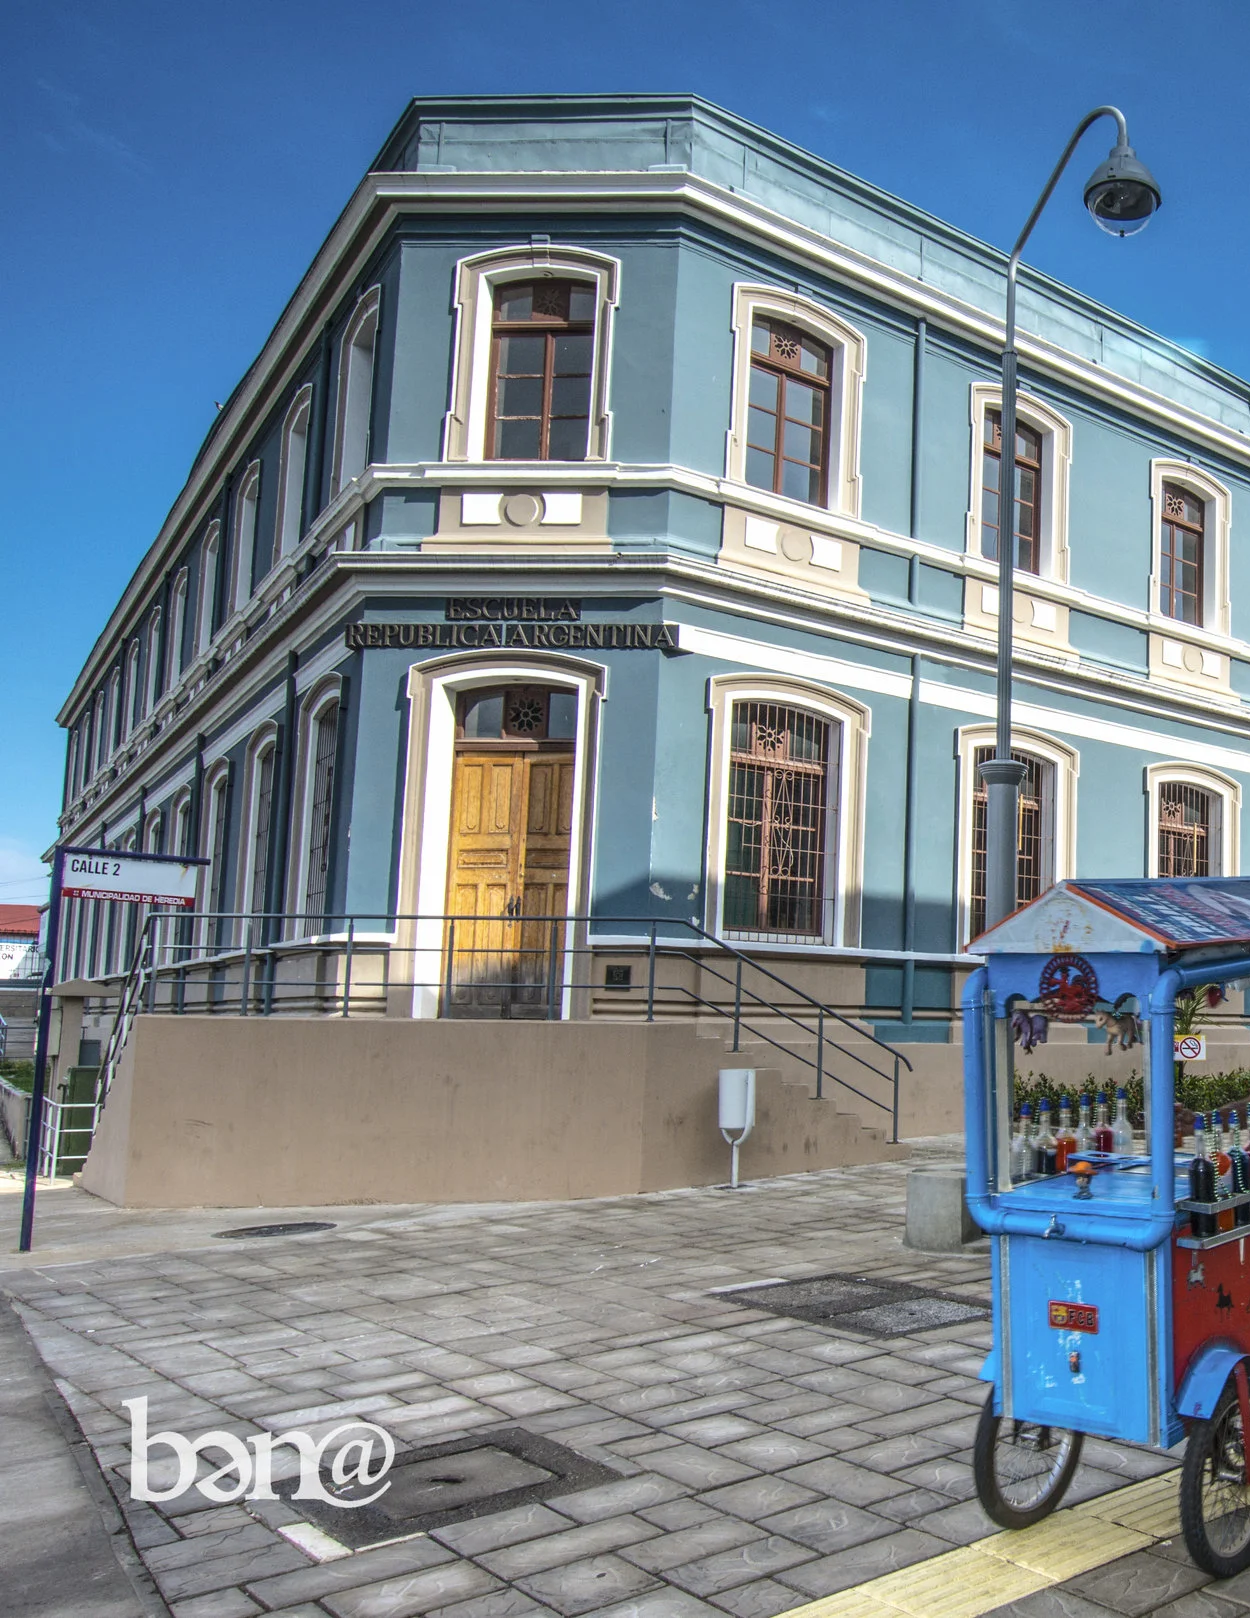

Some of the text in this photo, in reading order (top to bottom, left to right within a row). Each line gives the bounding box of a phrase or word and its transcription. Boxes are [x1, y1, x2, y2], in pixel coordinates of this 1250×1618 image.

[450, 598, 579, 620] ESCUELA
[349, 624, 676, 648] REPUBLICA ARGENTINA
[71, 858, 121, 877] CALLE 2
[81, 890, 186, 905] MUNICIPALIDAD DE HEREDIA
